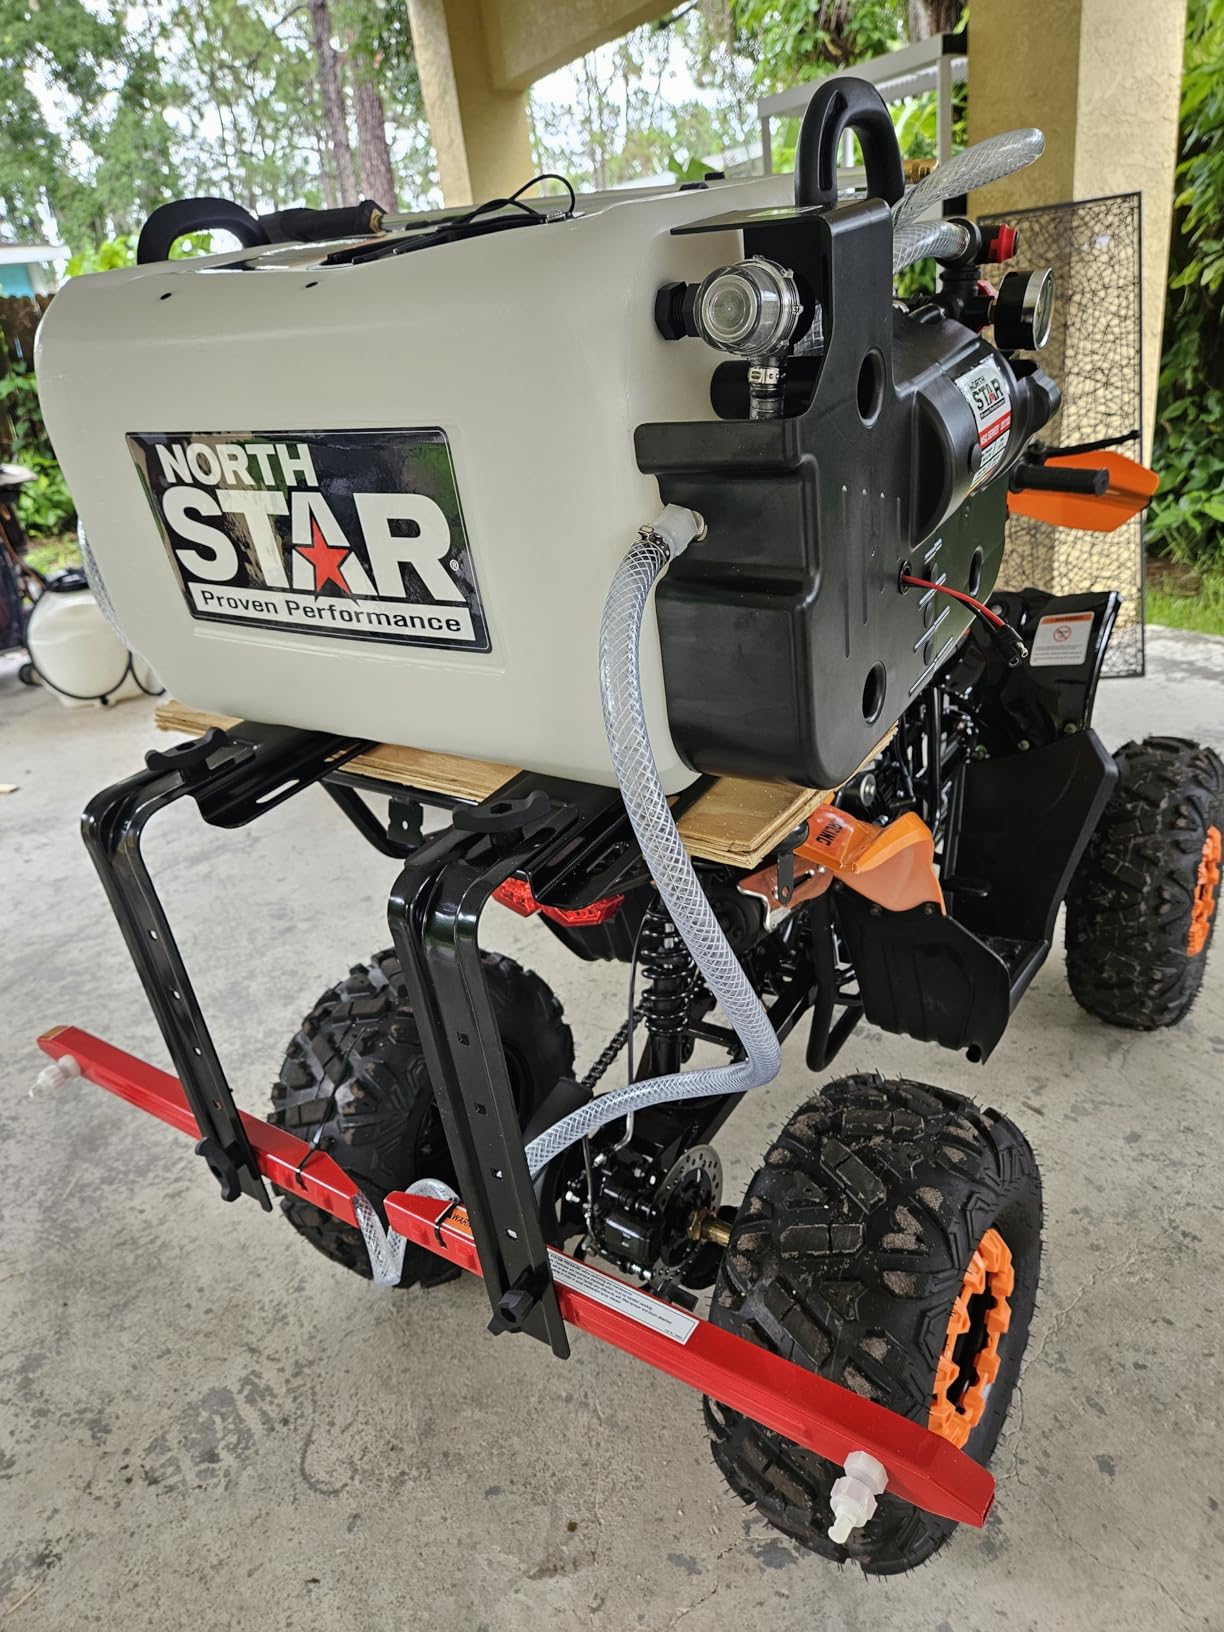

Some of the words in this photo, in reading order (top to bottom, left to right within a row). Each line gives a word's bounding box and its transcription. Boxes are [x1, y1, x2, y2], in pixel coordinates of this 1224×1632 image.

[968, 376, 985, 390] NORTH
[972, 379, 1004, 411] STAR
[155, 443, 319, 487] NORTH
[162, 486, 467, 602] STAR
[201, 590, 278, 615] Proven
[288, 600, 462, 632] Performance
